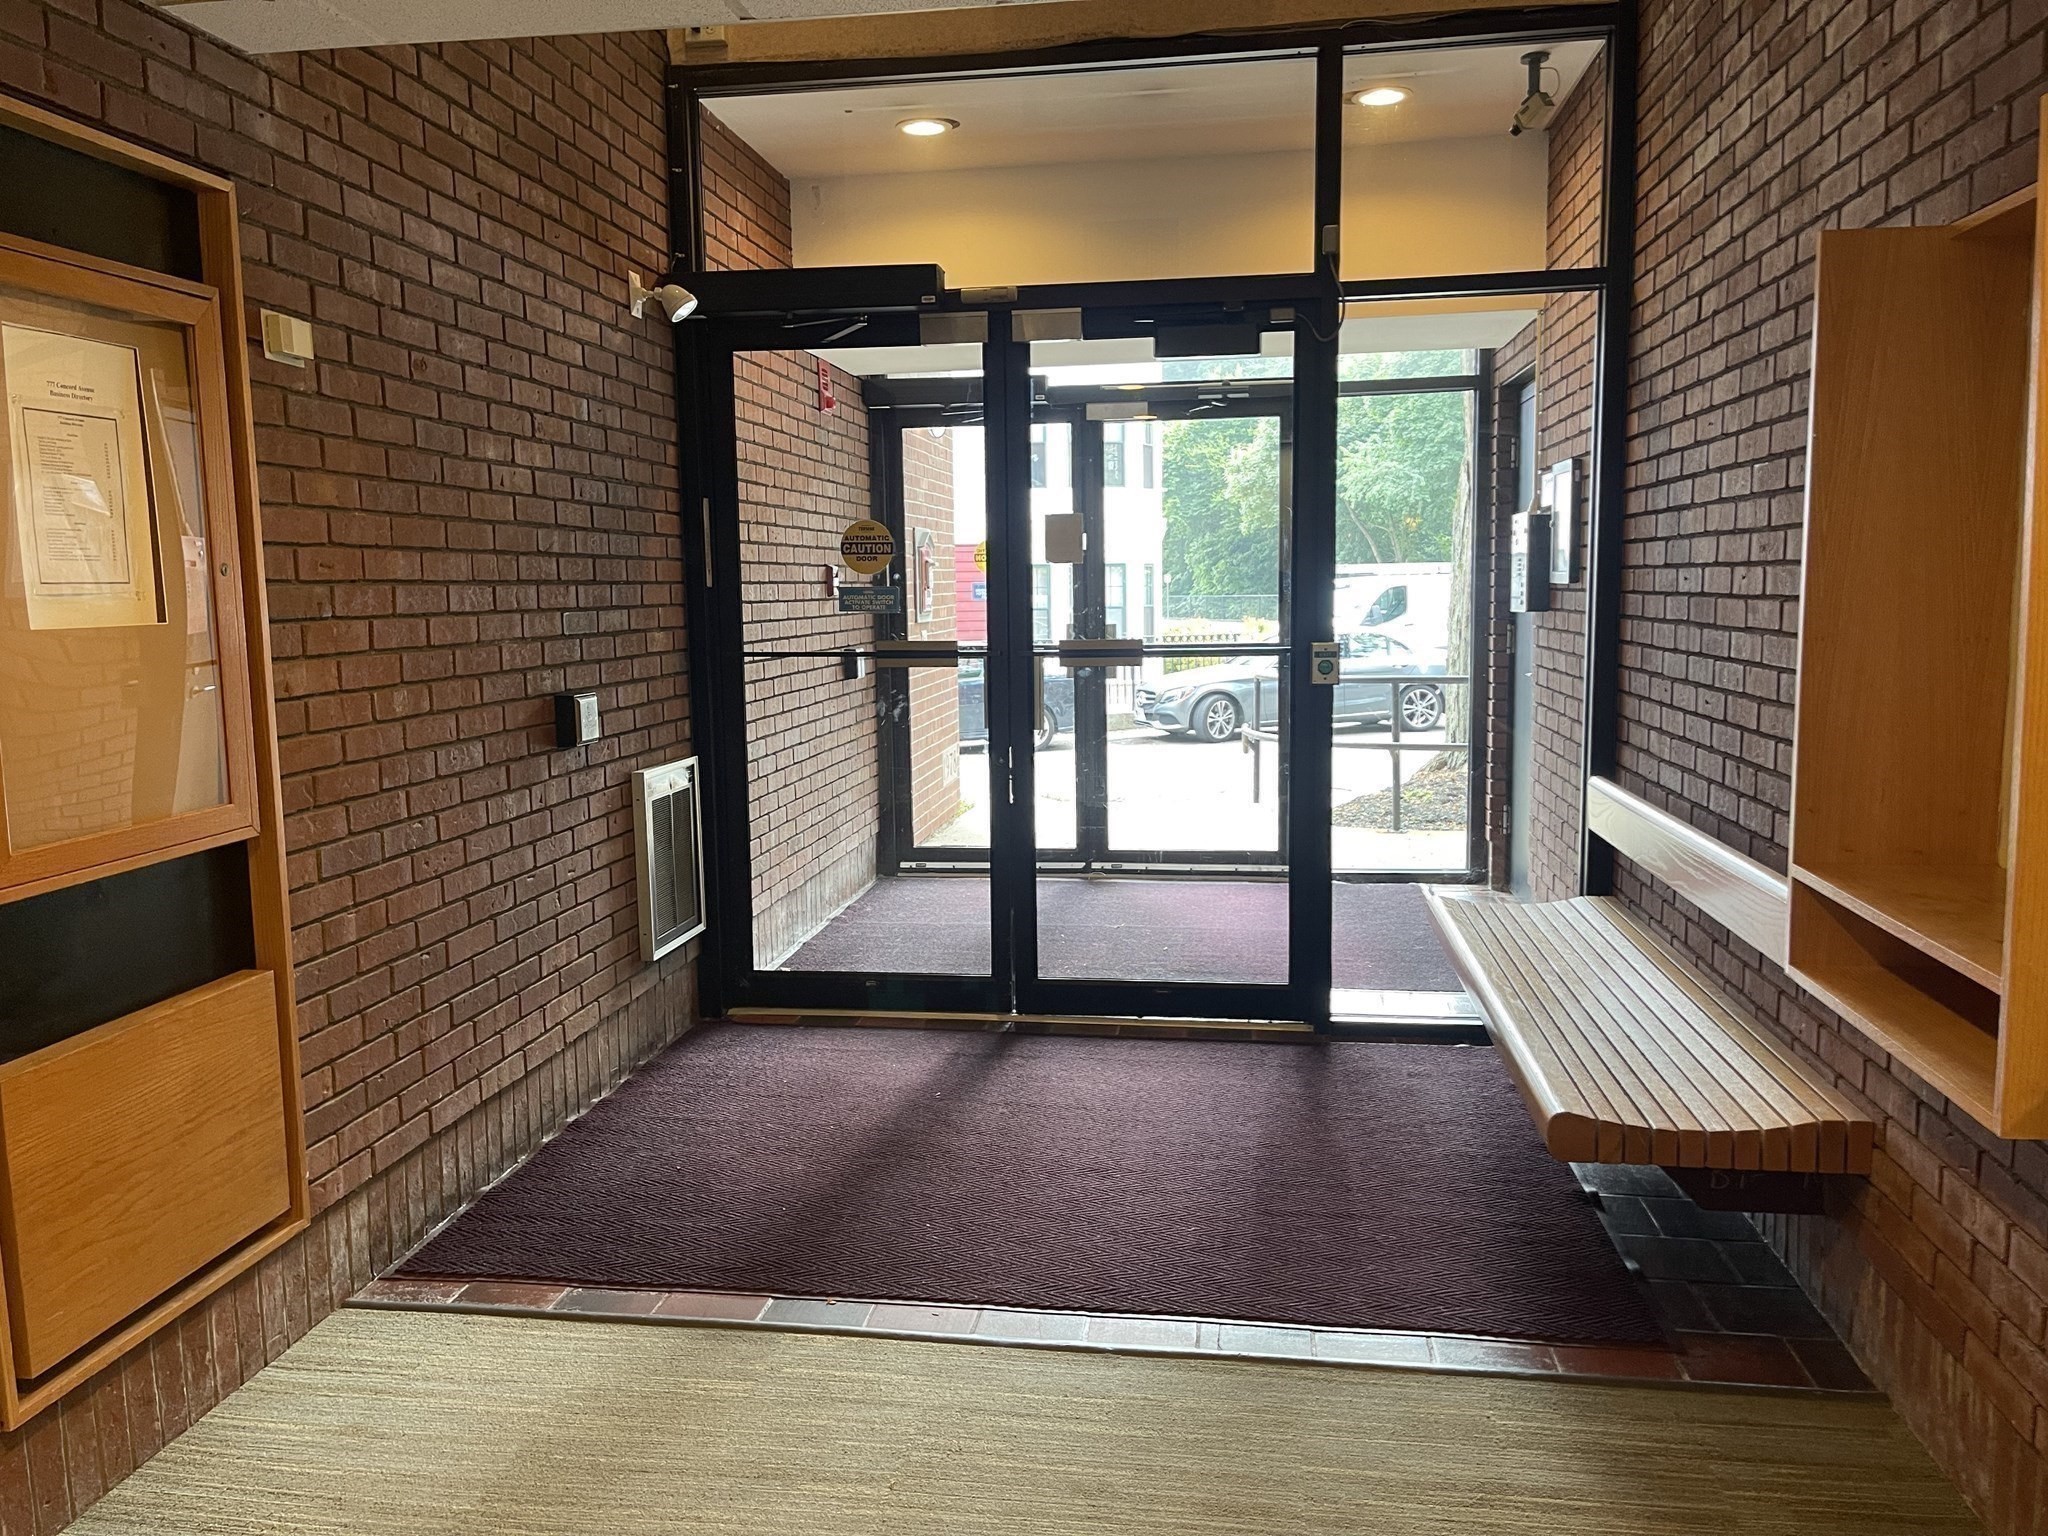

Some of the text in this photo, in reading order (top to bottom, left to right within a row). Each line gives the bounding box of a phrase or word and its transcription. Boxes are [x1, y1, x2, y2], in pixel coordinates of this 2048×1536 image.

[56, 382, 77, 390] Concord
[78, 385, 95, 393] Avenue
[50, 390, 93, 402] Business Directory
[843, 544, 891, 553] CAUTION
